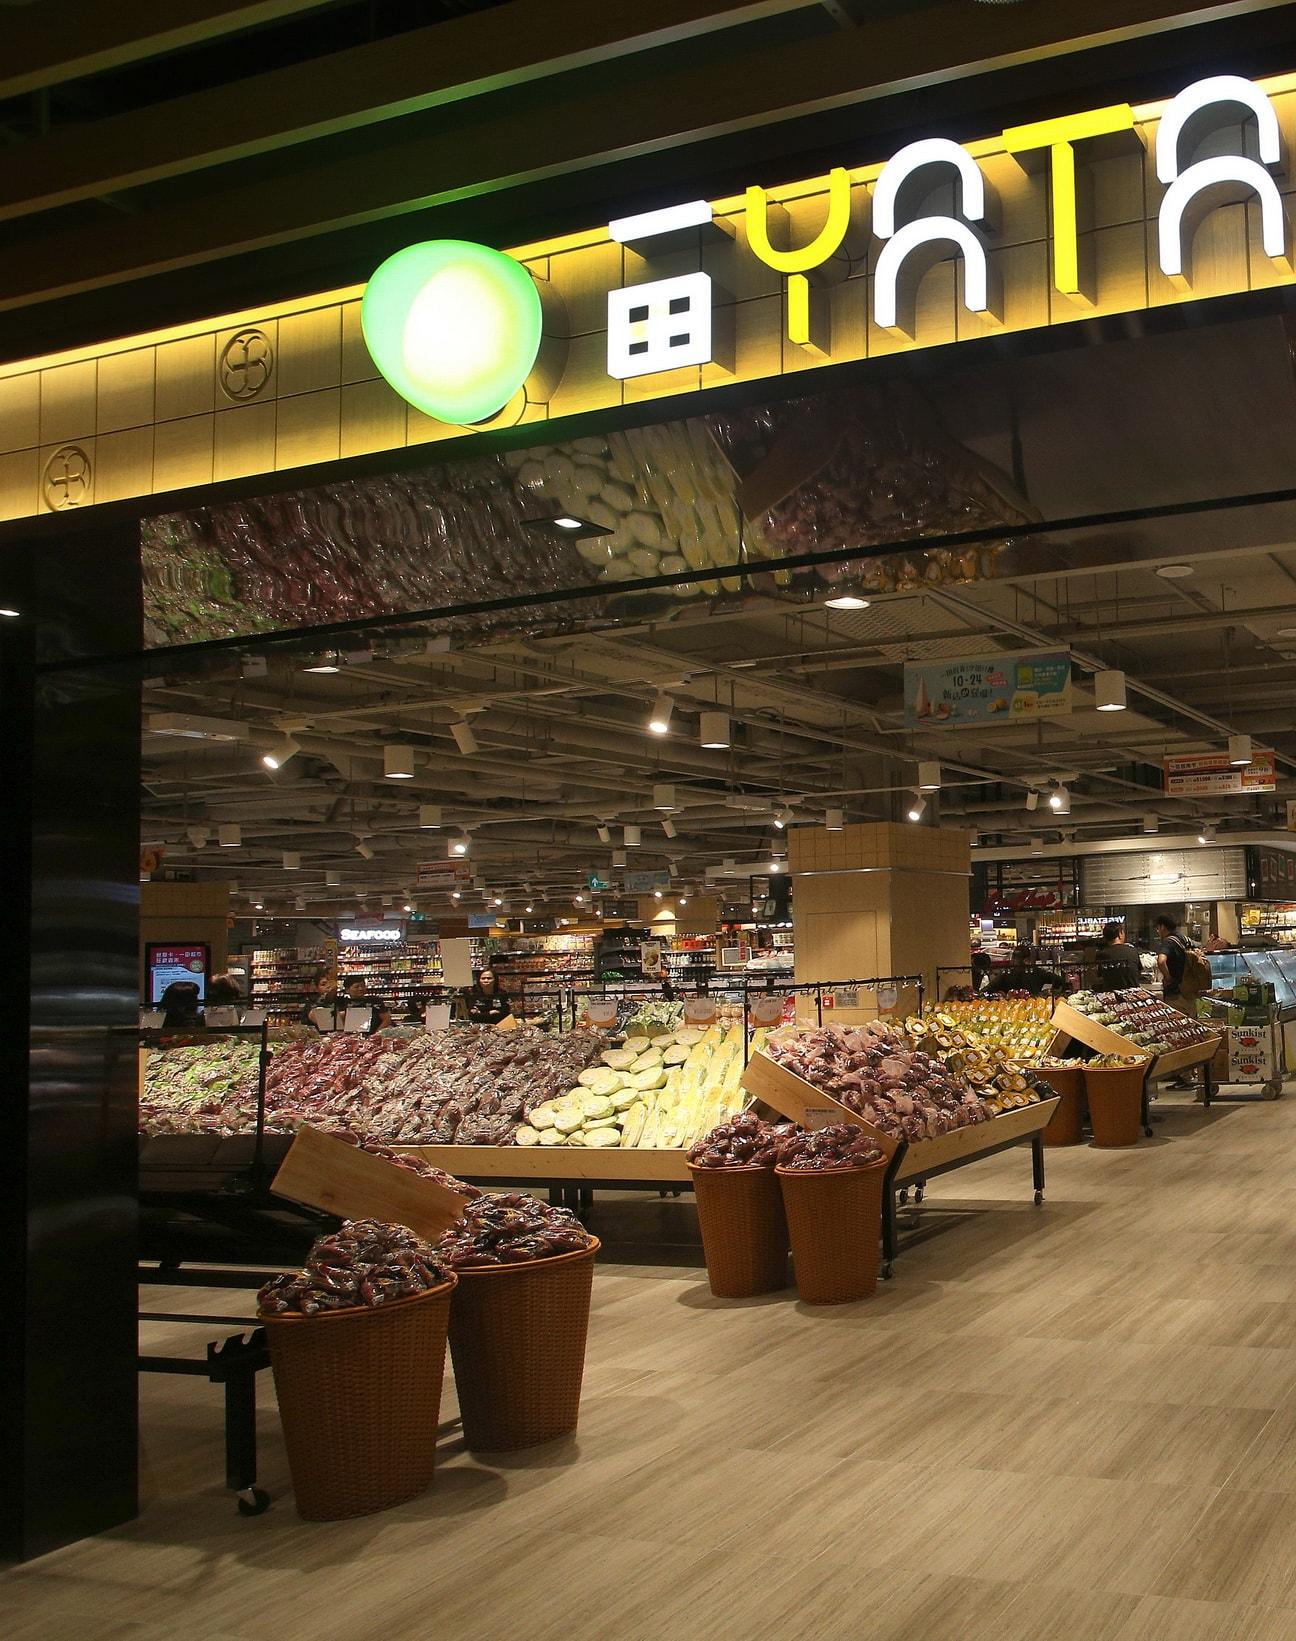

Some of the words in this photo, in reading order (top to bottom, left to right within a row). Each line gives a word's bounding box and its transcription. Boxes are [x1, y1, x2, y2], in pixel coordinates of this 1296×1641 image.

[745, 75, 1285, 345] YATA
[608, 200, 712, 380] 一田
[340, 928, 401, 940] SEAFOOD
[1231, 1028, 1267, 1038] Sunkist
[1231, 1055, 1267, 1065] Sunkist
